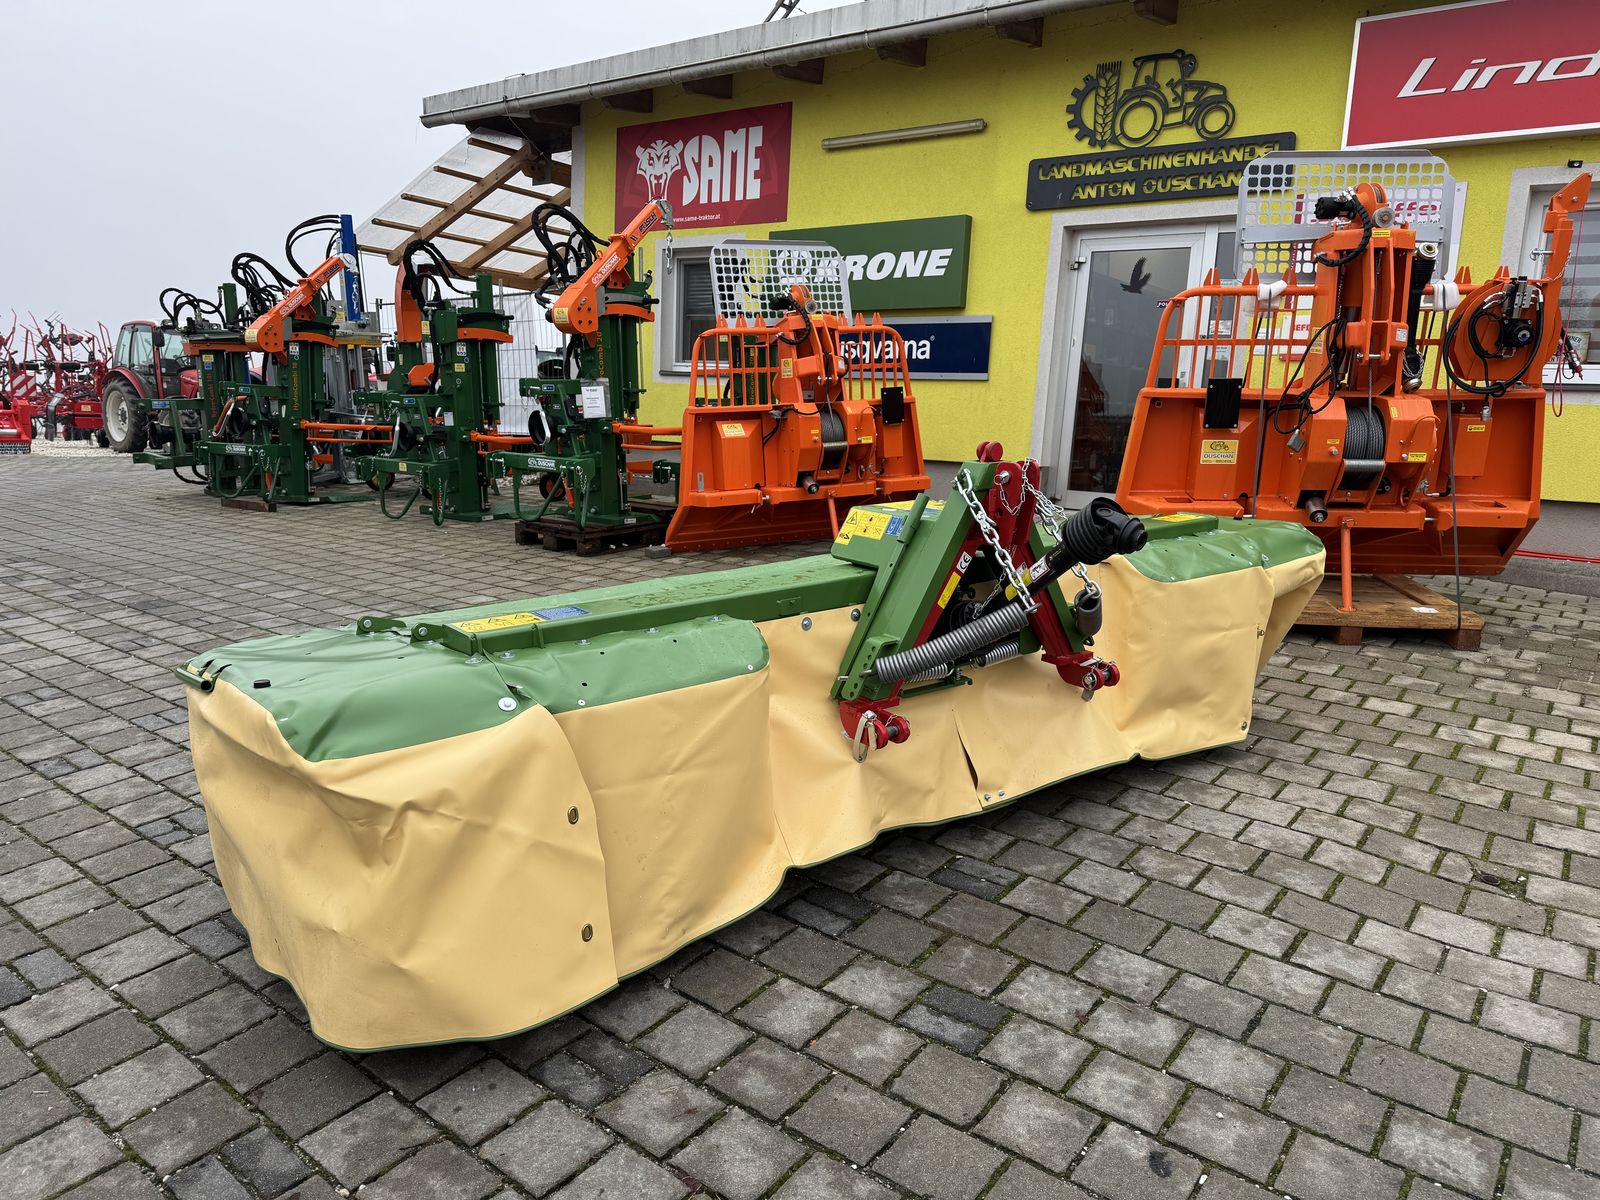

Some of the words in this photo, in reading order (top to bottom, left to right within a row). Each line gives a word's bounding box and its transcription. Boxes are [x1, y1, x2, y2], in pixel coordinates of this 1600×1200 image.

[682, 125, 764, 207] SAME
[1071, 179, 1136, 201] ANTON
[1142, 169, 1242, 193] OUSCHAN
